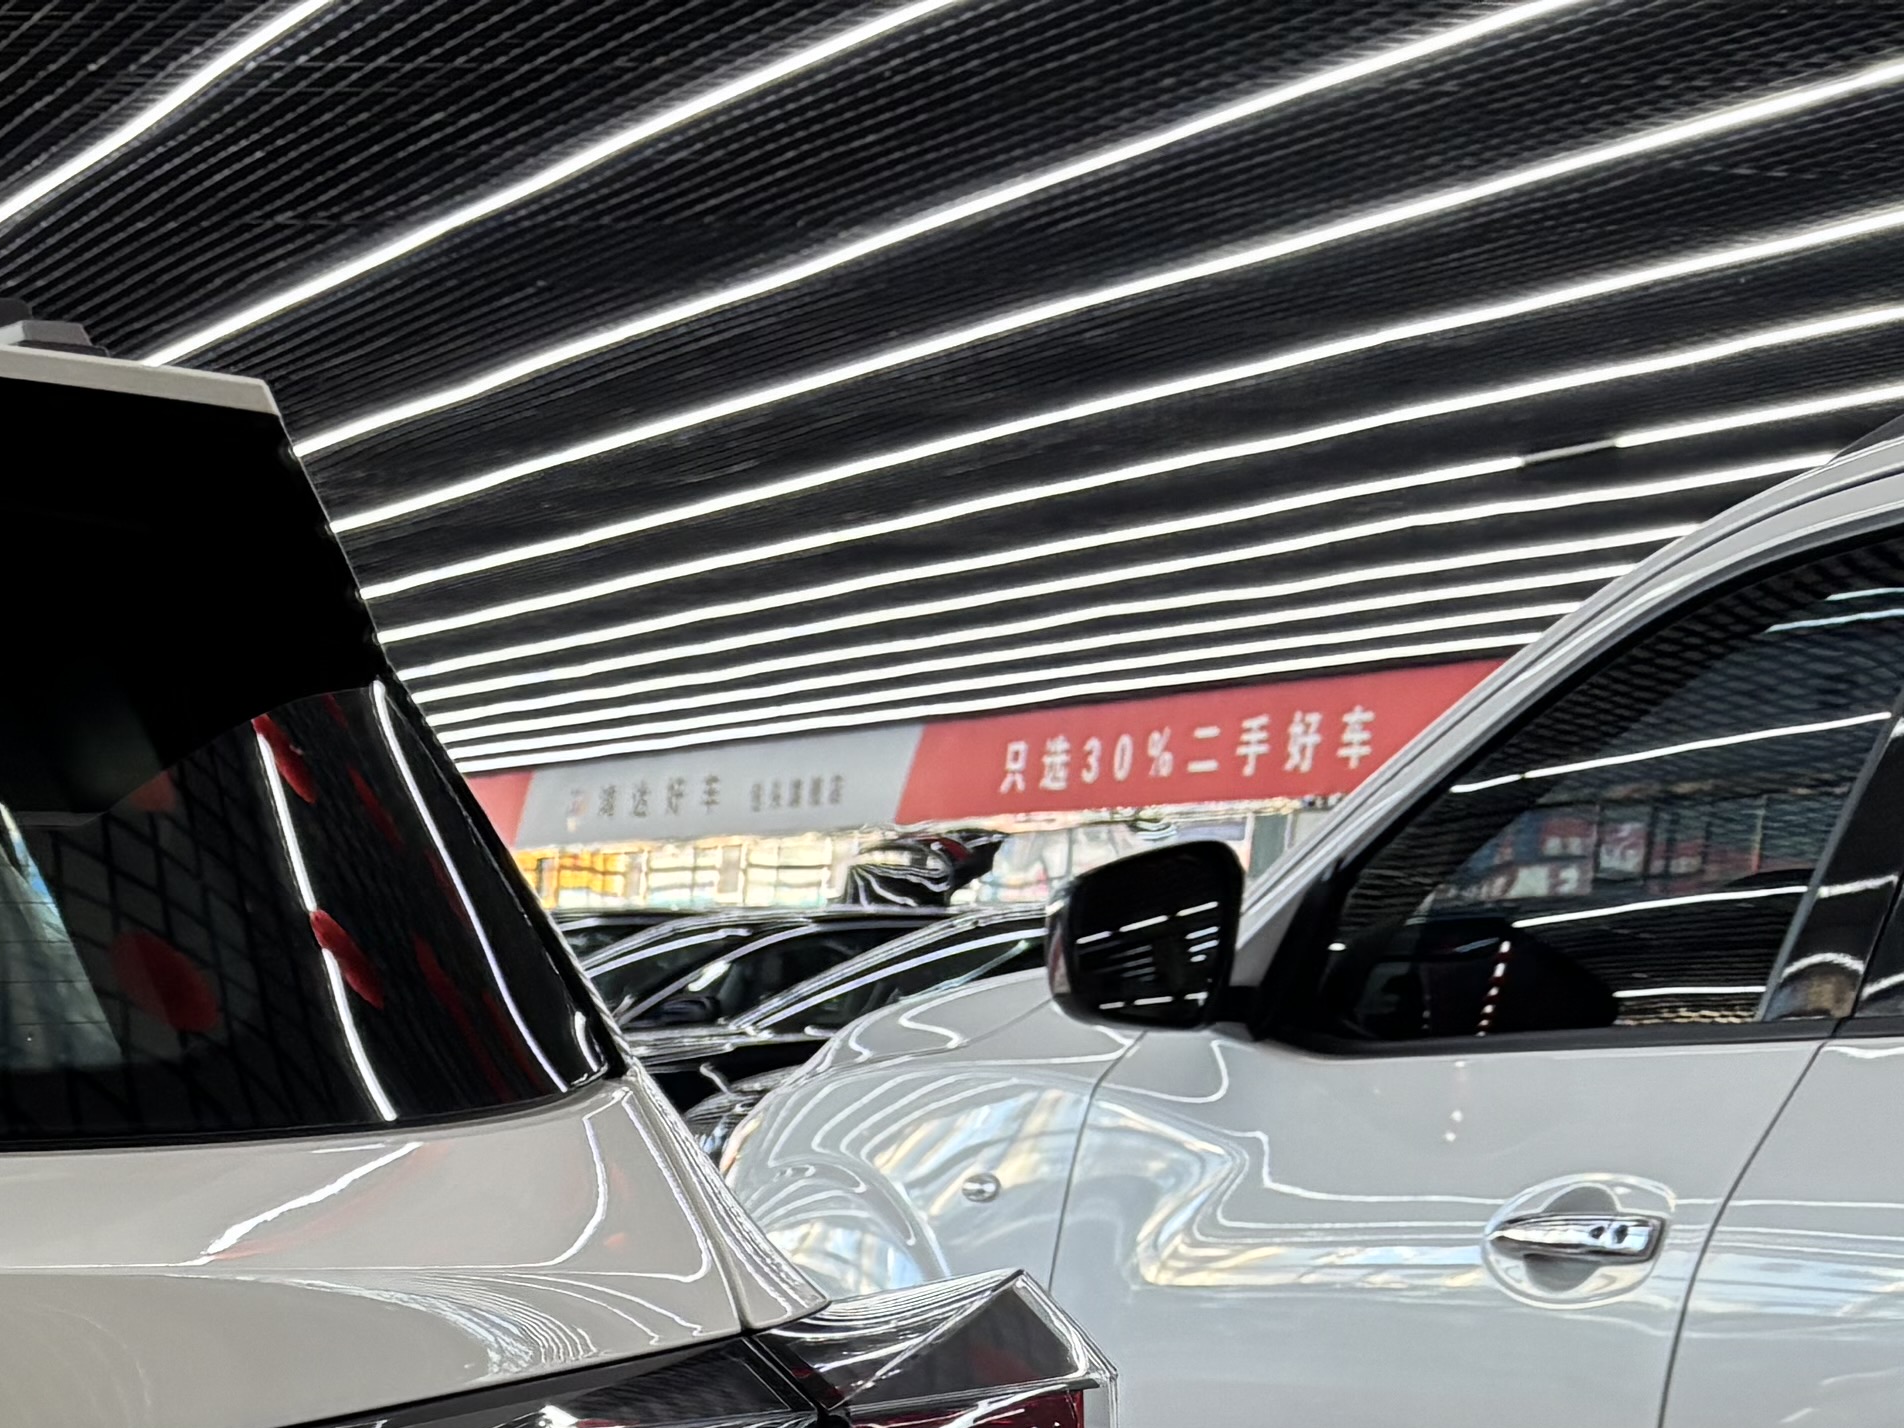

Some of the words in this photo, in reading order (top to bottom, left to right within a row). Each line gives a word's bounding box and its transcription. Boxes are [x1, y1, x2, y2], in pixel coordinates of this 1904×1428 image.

[999, 705, 1375, 793] 只选30%二手好车
